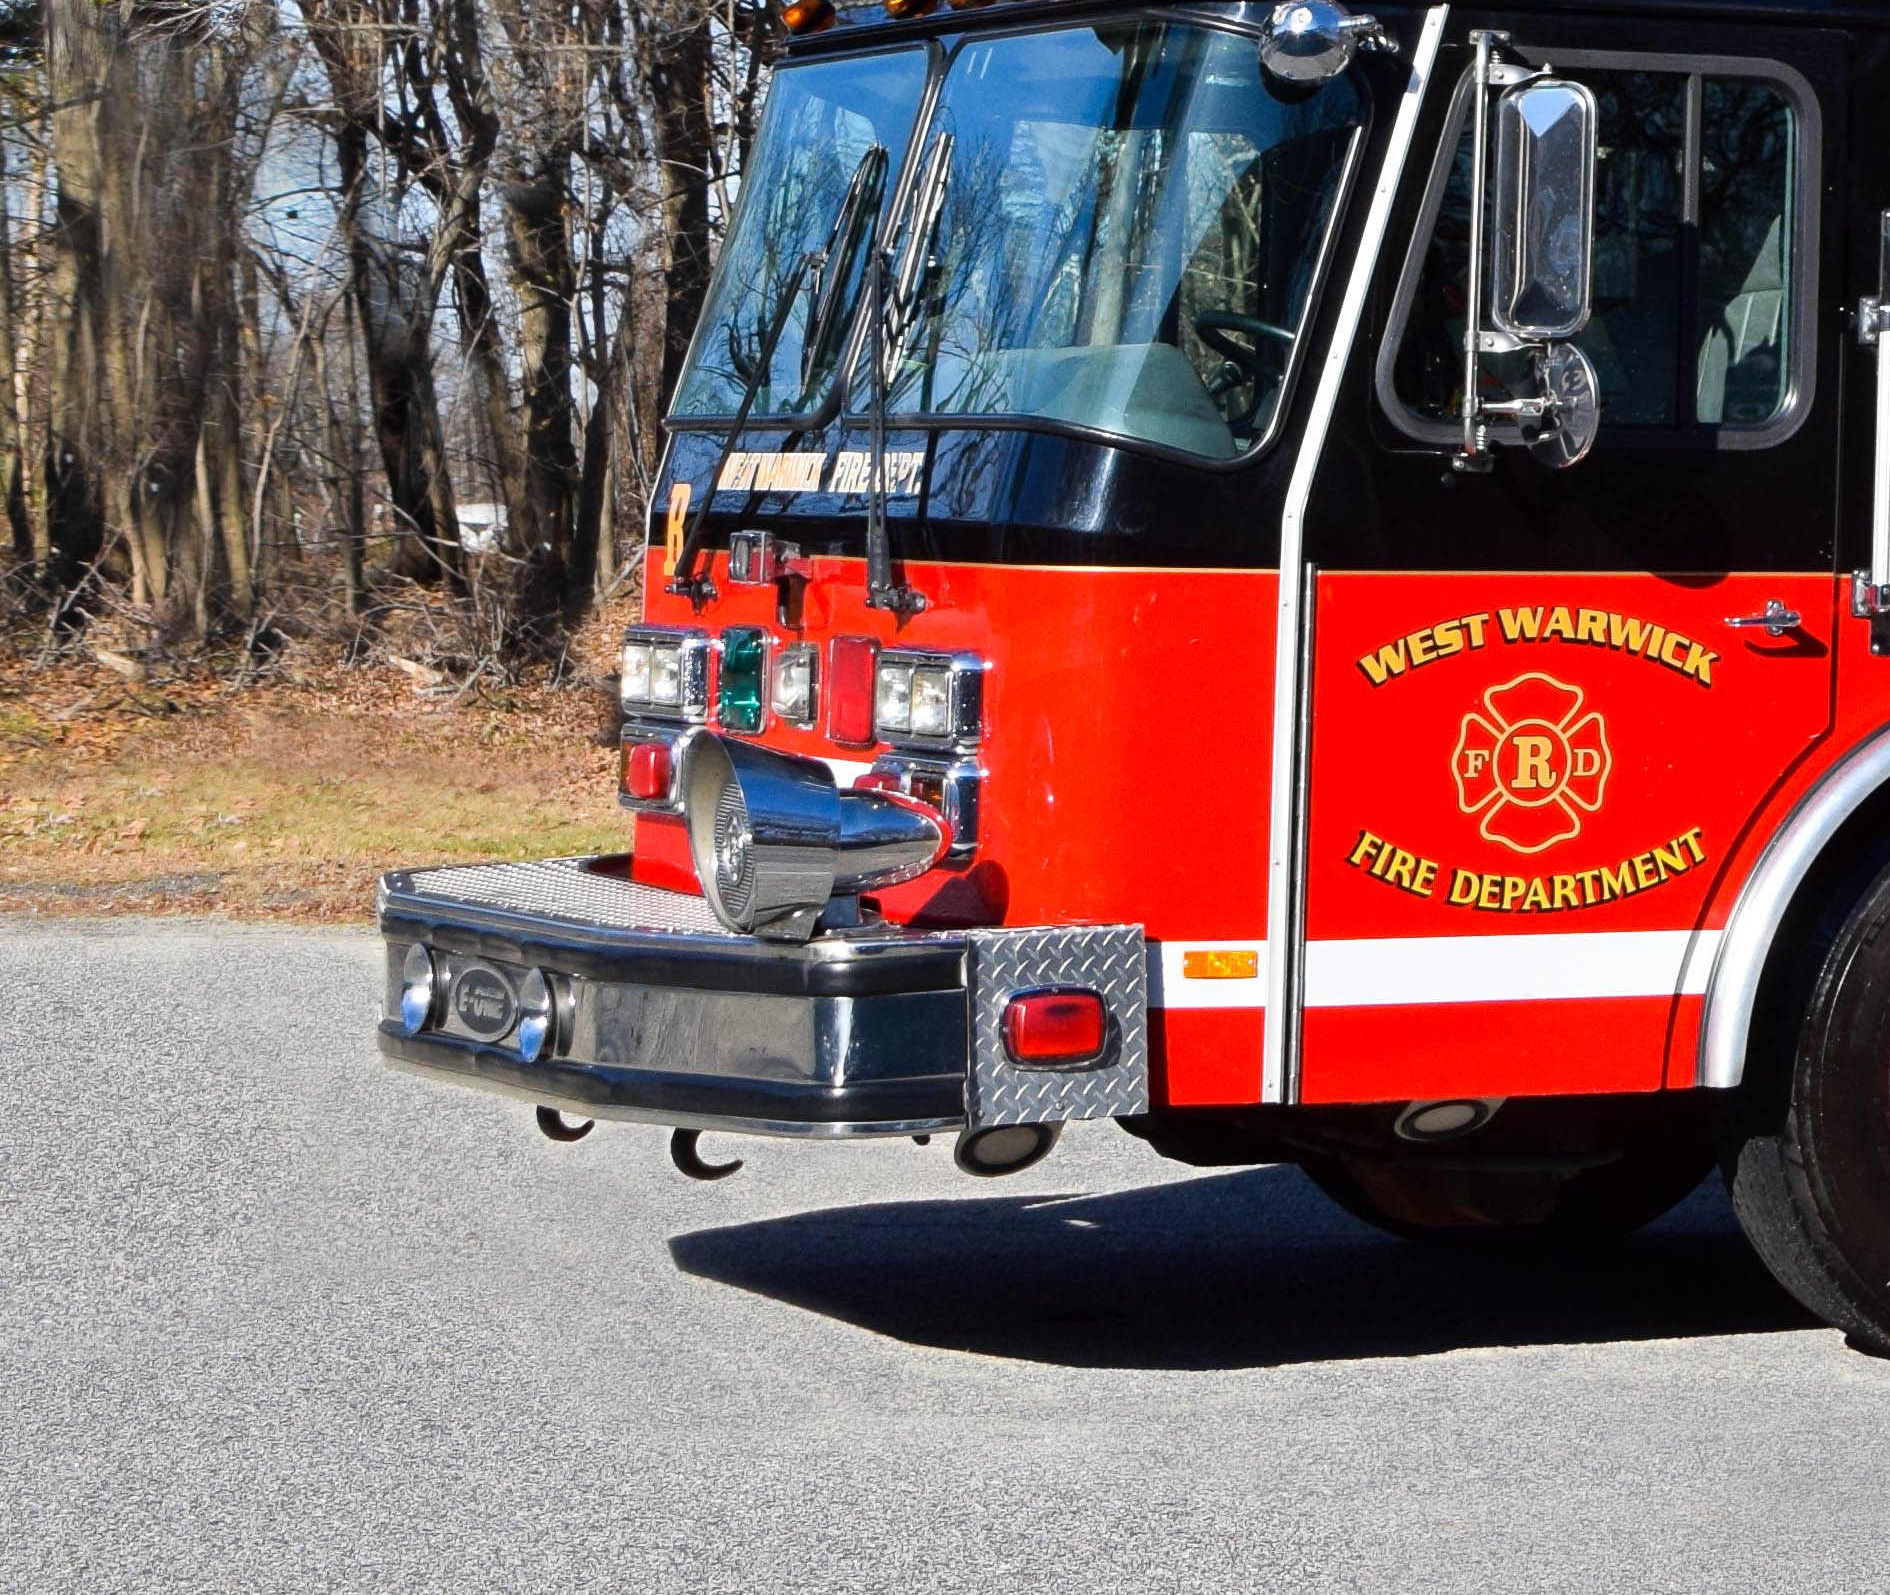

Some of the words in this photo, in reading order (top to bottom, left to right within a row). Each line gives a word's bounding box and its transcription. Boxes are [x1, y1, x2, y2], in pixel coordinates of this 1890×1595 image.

[754, 453, 827, 492] WARWICK
[828, 451, 871, 493] FIRE
[1357, 612, 1489, 686] WEST
[1499, 606, 1720, 688] WARWICK
[1464, 749, 1490, 778] F
[1511, 735, 1557, 789] R
[1572, 748, 1601, 777] D
[1346, 830, 1440, 895] FIRE
[1448, 827, 1707, 912] DEPARTMENT
